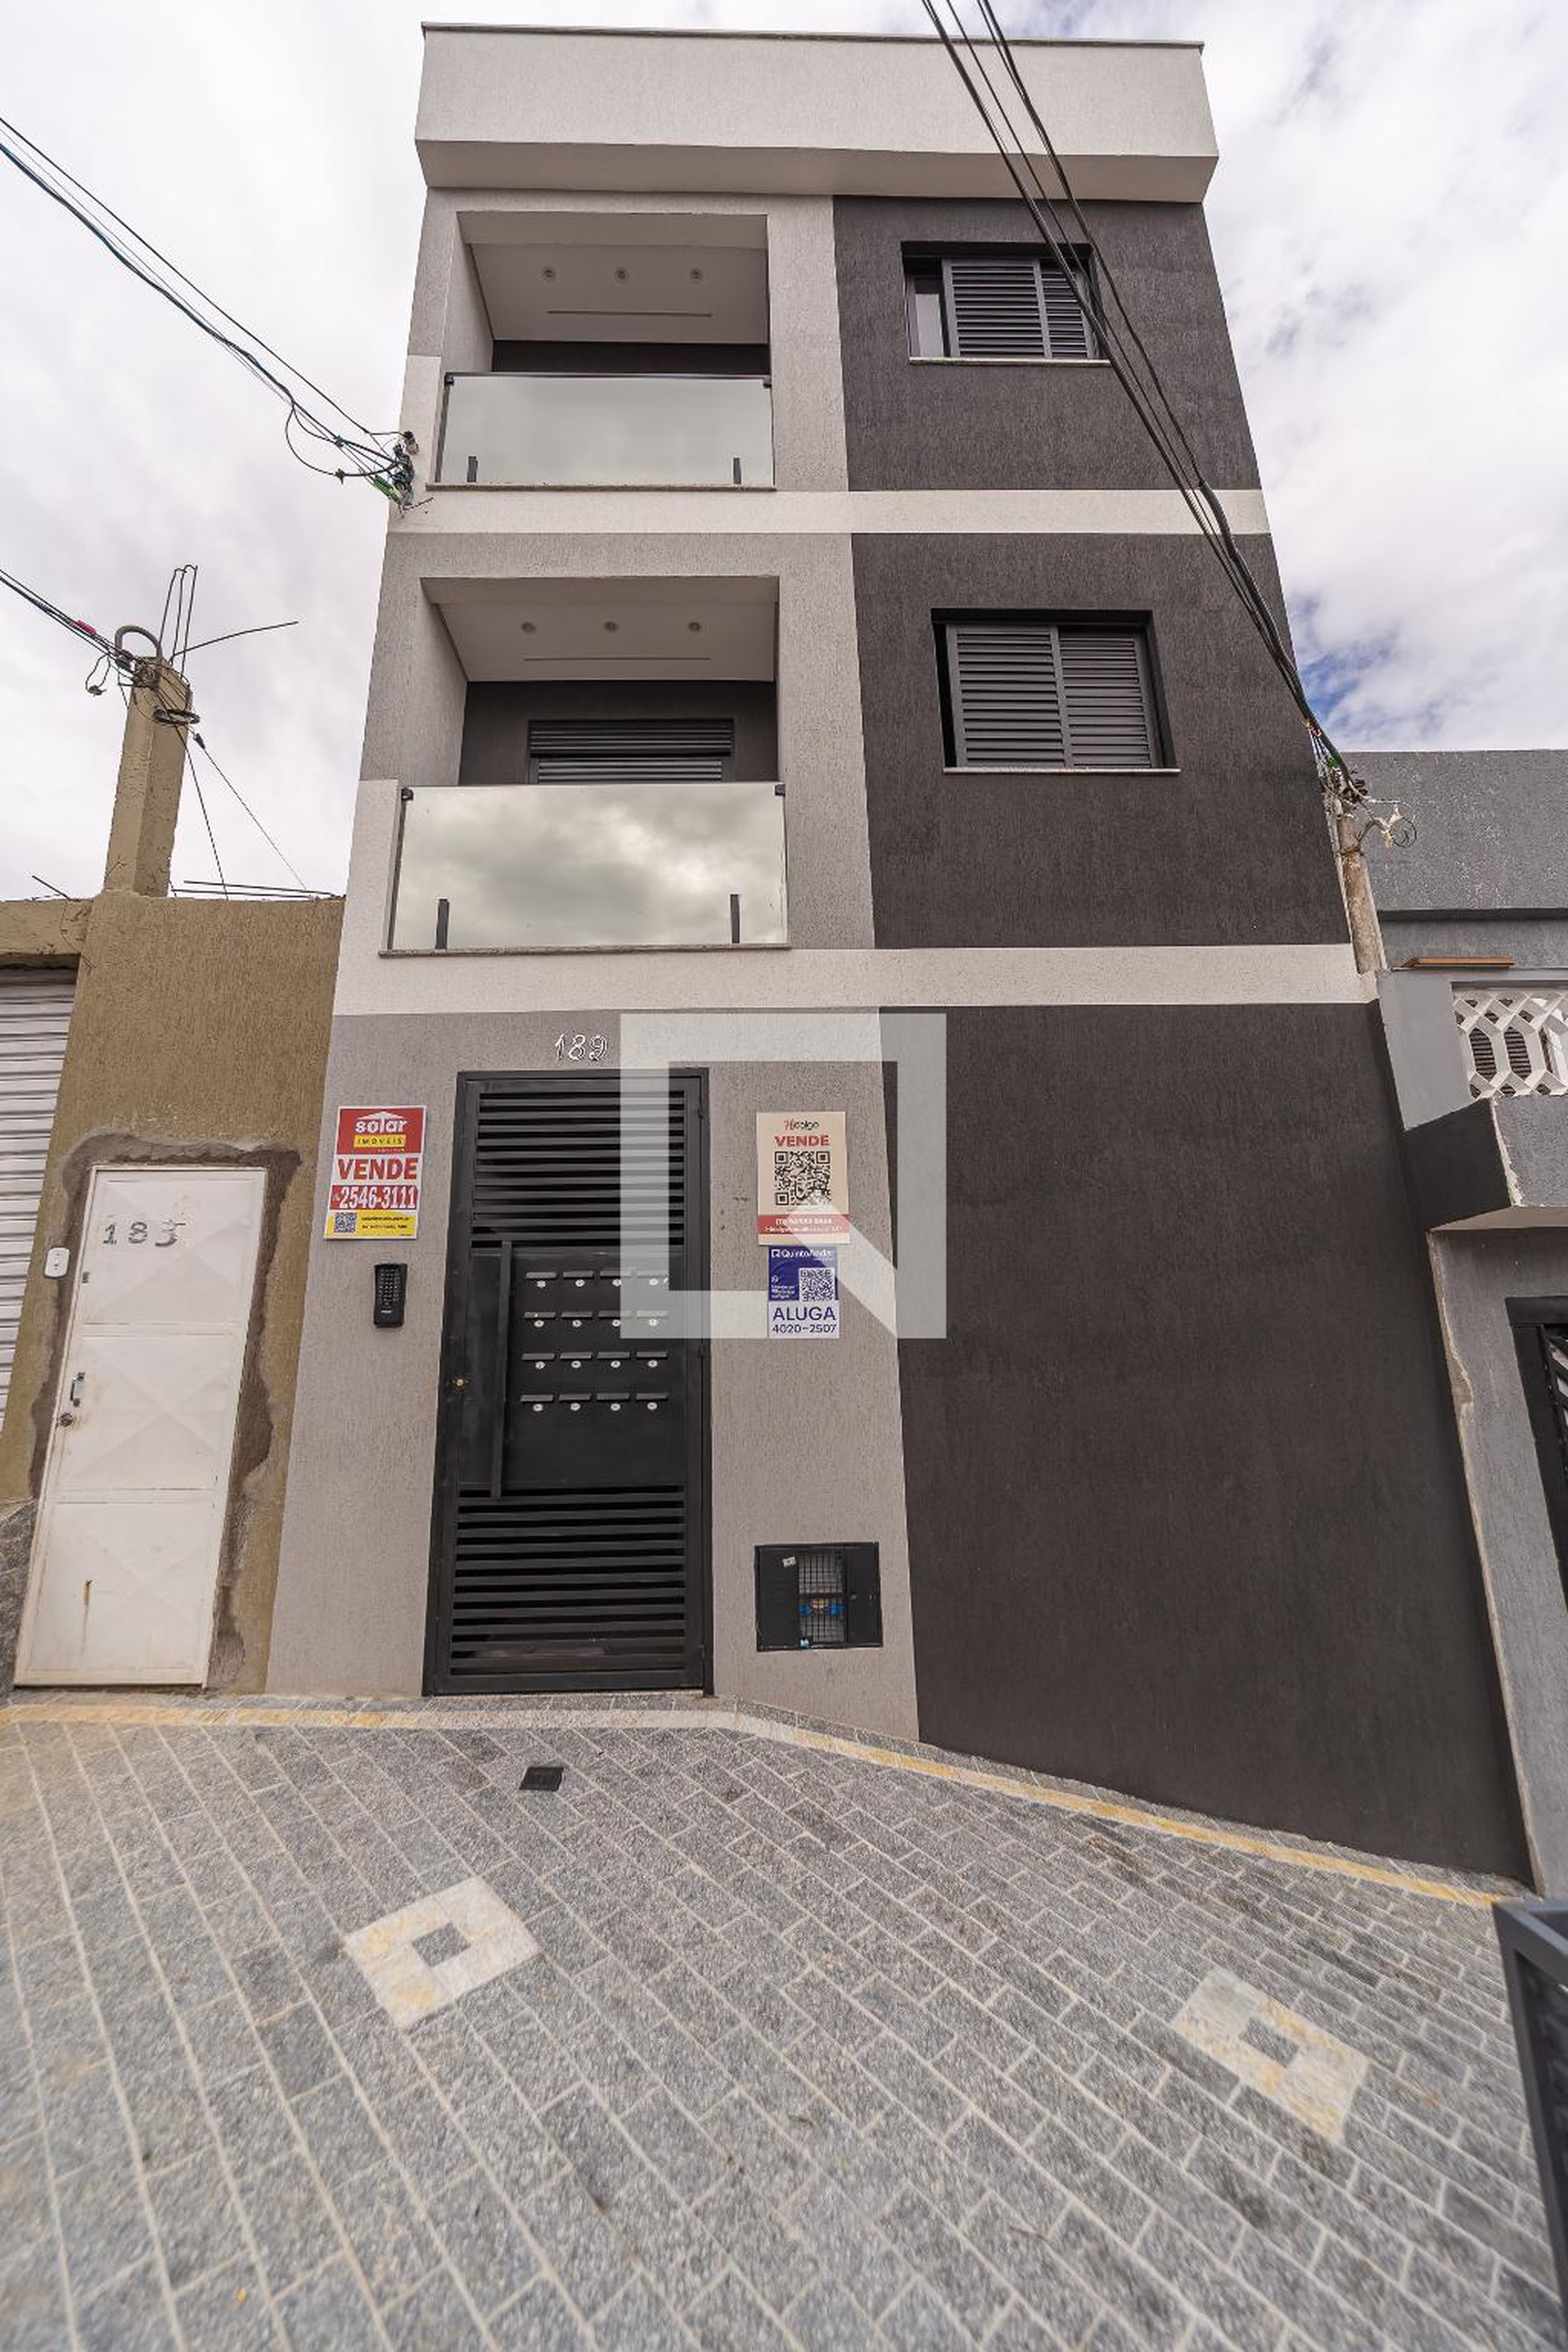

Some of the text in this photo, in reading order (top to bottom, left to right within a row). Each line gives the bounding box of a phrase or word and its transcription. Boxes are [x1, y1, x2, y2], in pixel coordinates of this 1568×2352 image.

[555, 1033, 608, 1060] 189
[355, 1118, 407, 1134] solar
[775, 1136, 830, 1147] VENDE
[338, 1158, 419, 1179] VENDE
[339, 1186, 416, 1209] 2546-3111
[103, 1220, 187, 1247] 185
[773, 1307, 836, 1321] ALUGA
[772, 1324, 837, 1333] 4020-2507
